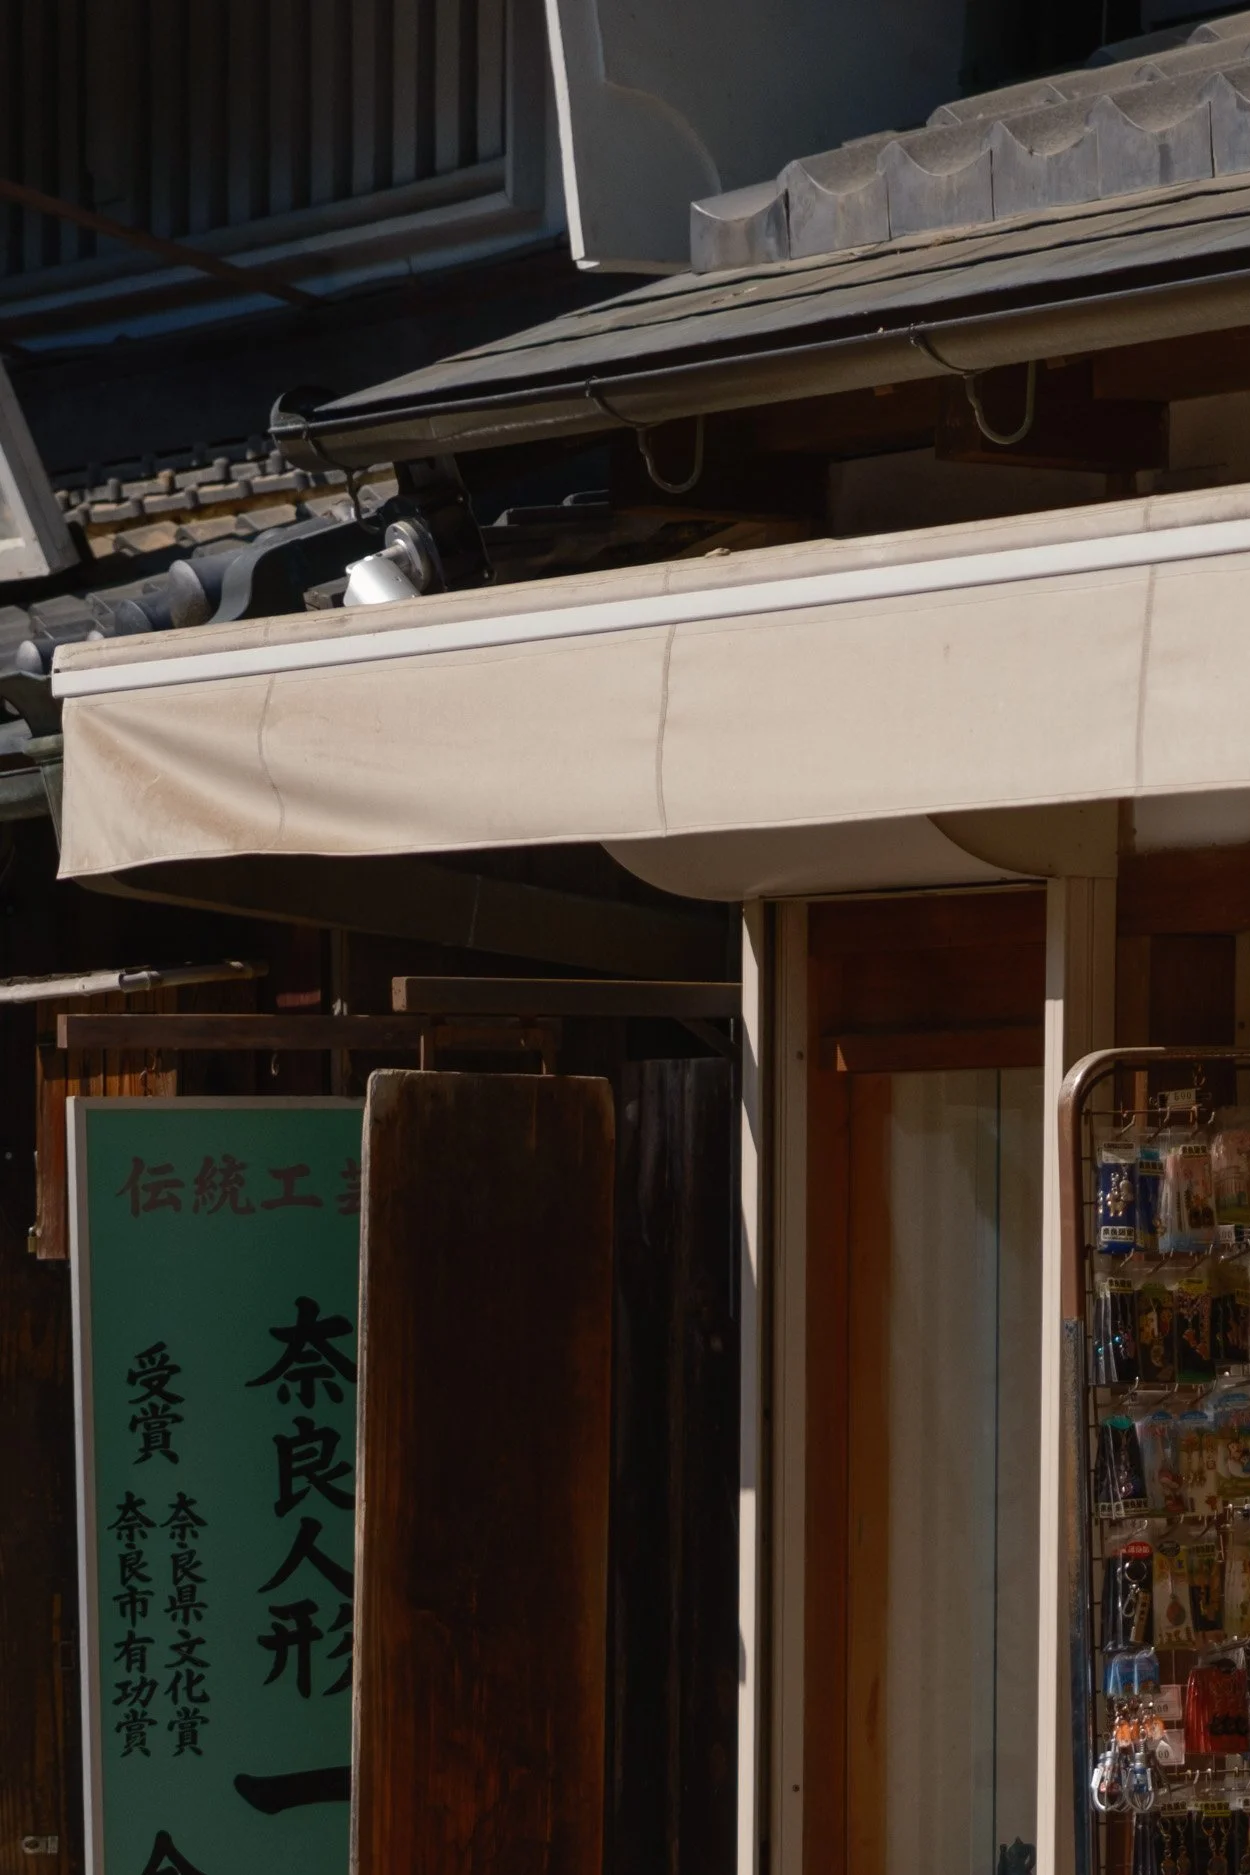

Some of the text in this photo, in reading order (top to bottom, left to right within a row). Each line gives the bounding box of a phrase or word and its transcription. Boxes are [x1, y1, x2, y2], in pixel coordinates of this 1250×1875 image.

[125, 1340, 186, 1466] 受賞
[106, 1490, 159, 1758] 奈良市有功賞
[158, 1490, 211, 1758] 奈良県文化賞
